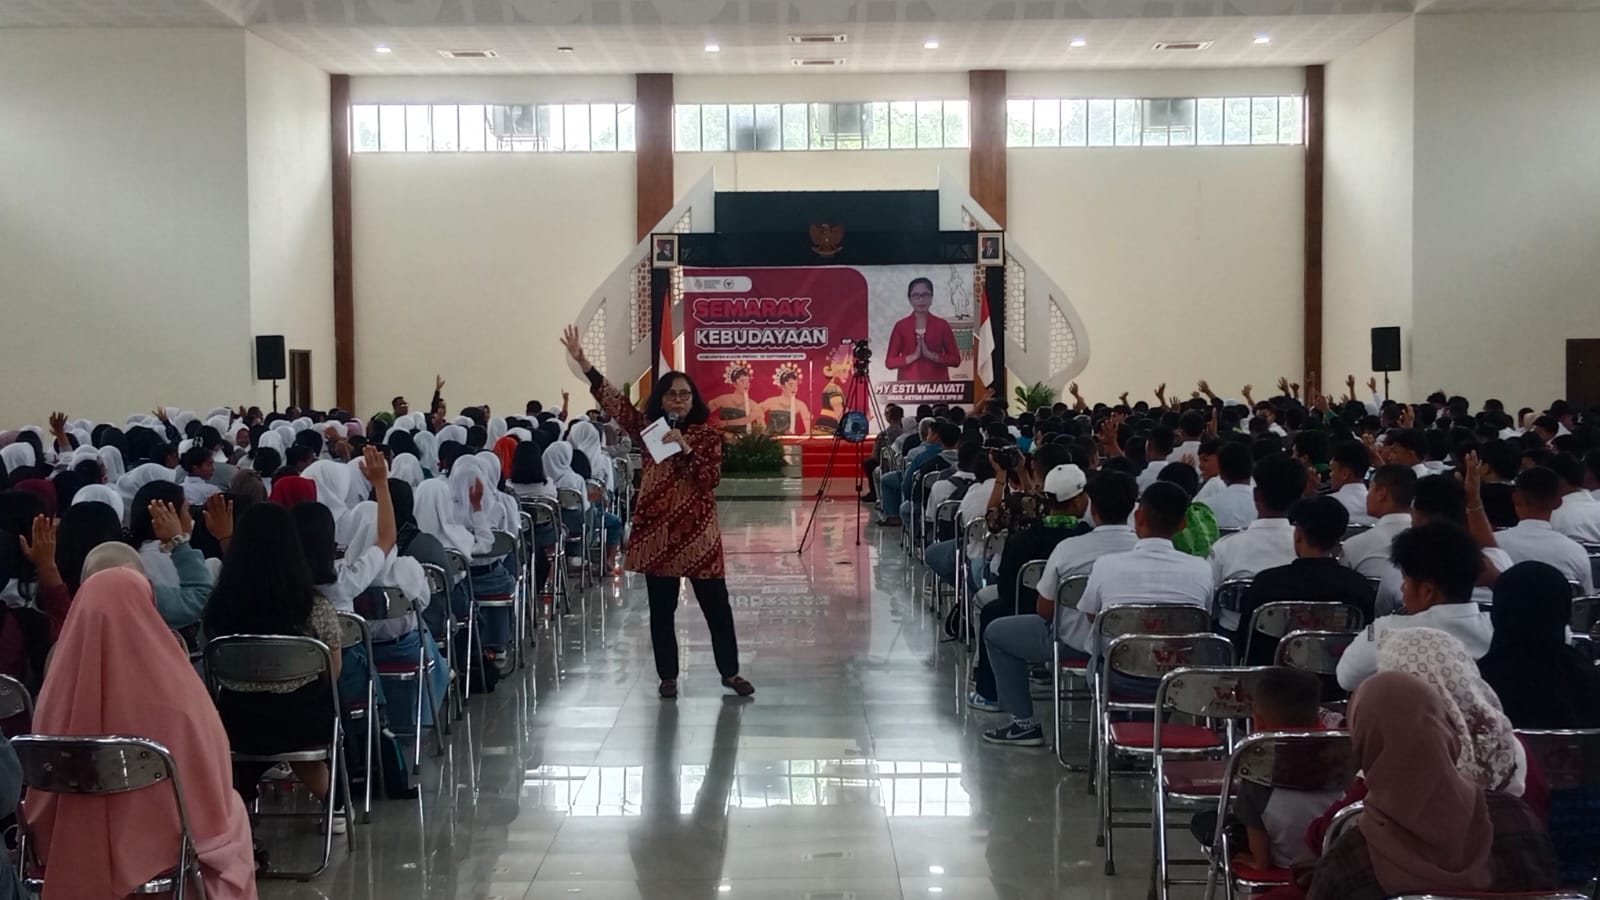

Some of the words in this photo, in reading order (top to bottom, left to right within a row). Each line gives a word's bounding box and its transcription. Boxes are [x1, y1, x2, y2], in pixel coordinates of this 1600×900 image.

[694, 299, 810, 323] SEMARAK
[696, 329, 827, 346] KEBUDAYAAN
[892, 384, 915, 393] ESTI
[916, 384, 965, 393] WIJAYATI
